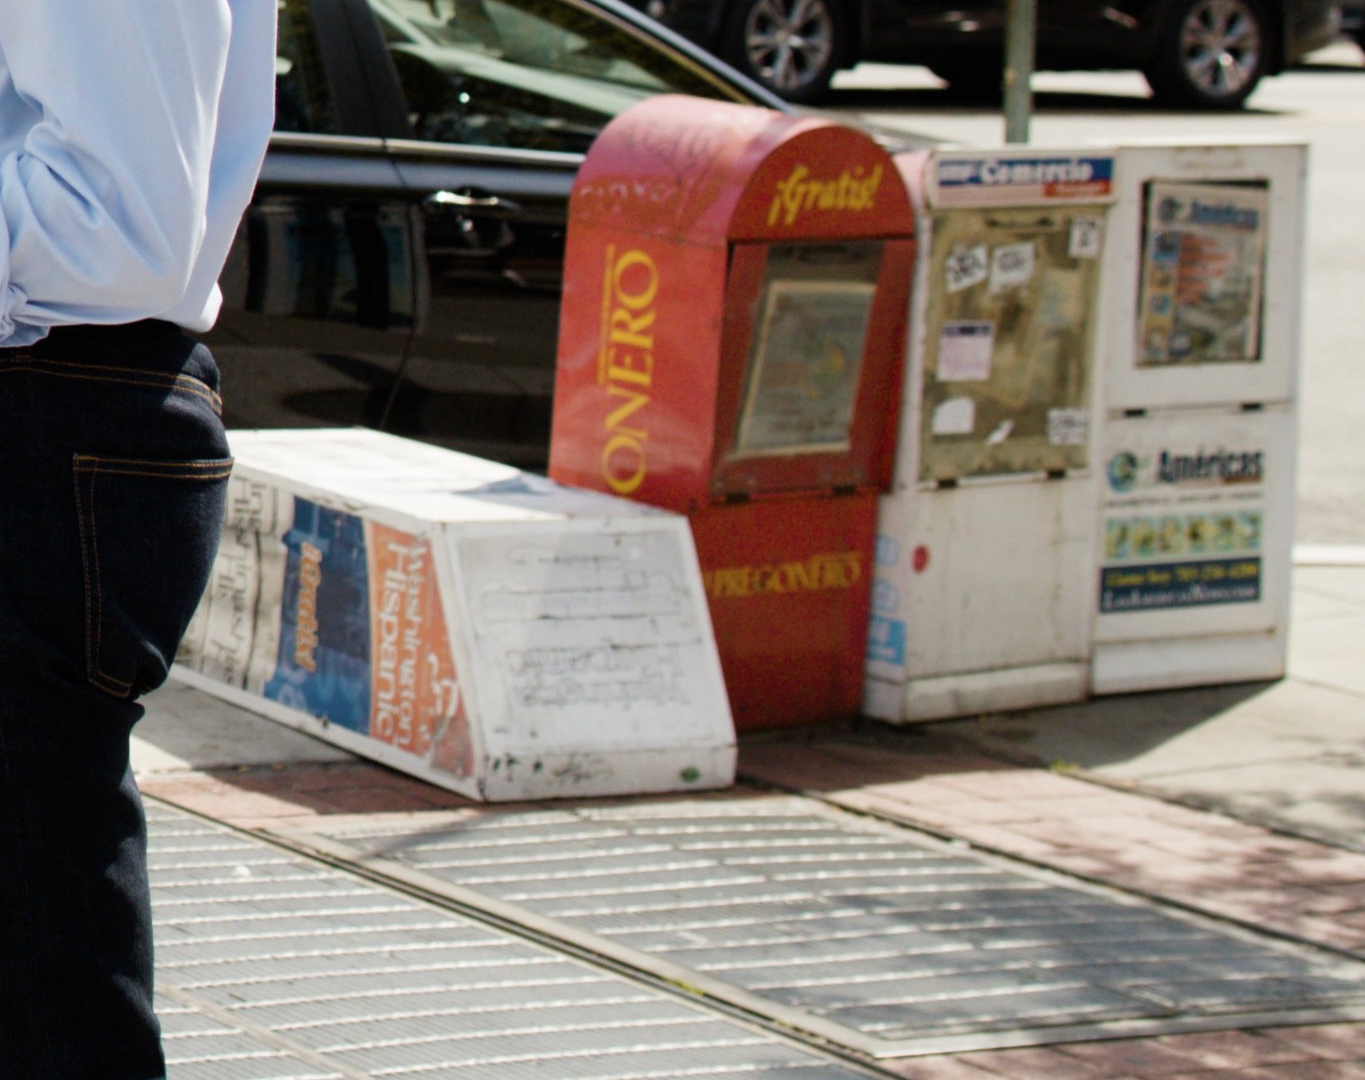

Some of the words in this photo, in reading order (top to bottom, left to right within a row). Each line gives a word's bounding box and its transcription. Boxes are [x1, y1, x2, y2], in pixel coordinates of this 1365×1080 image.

[980, 156, 1093, 186] Comercio
[375, 541, 411, 736] Hispanic
[393, 543, 428, 748] Washington
